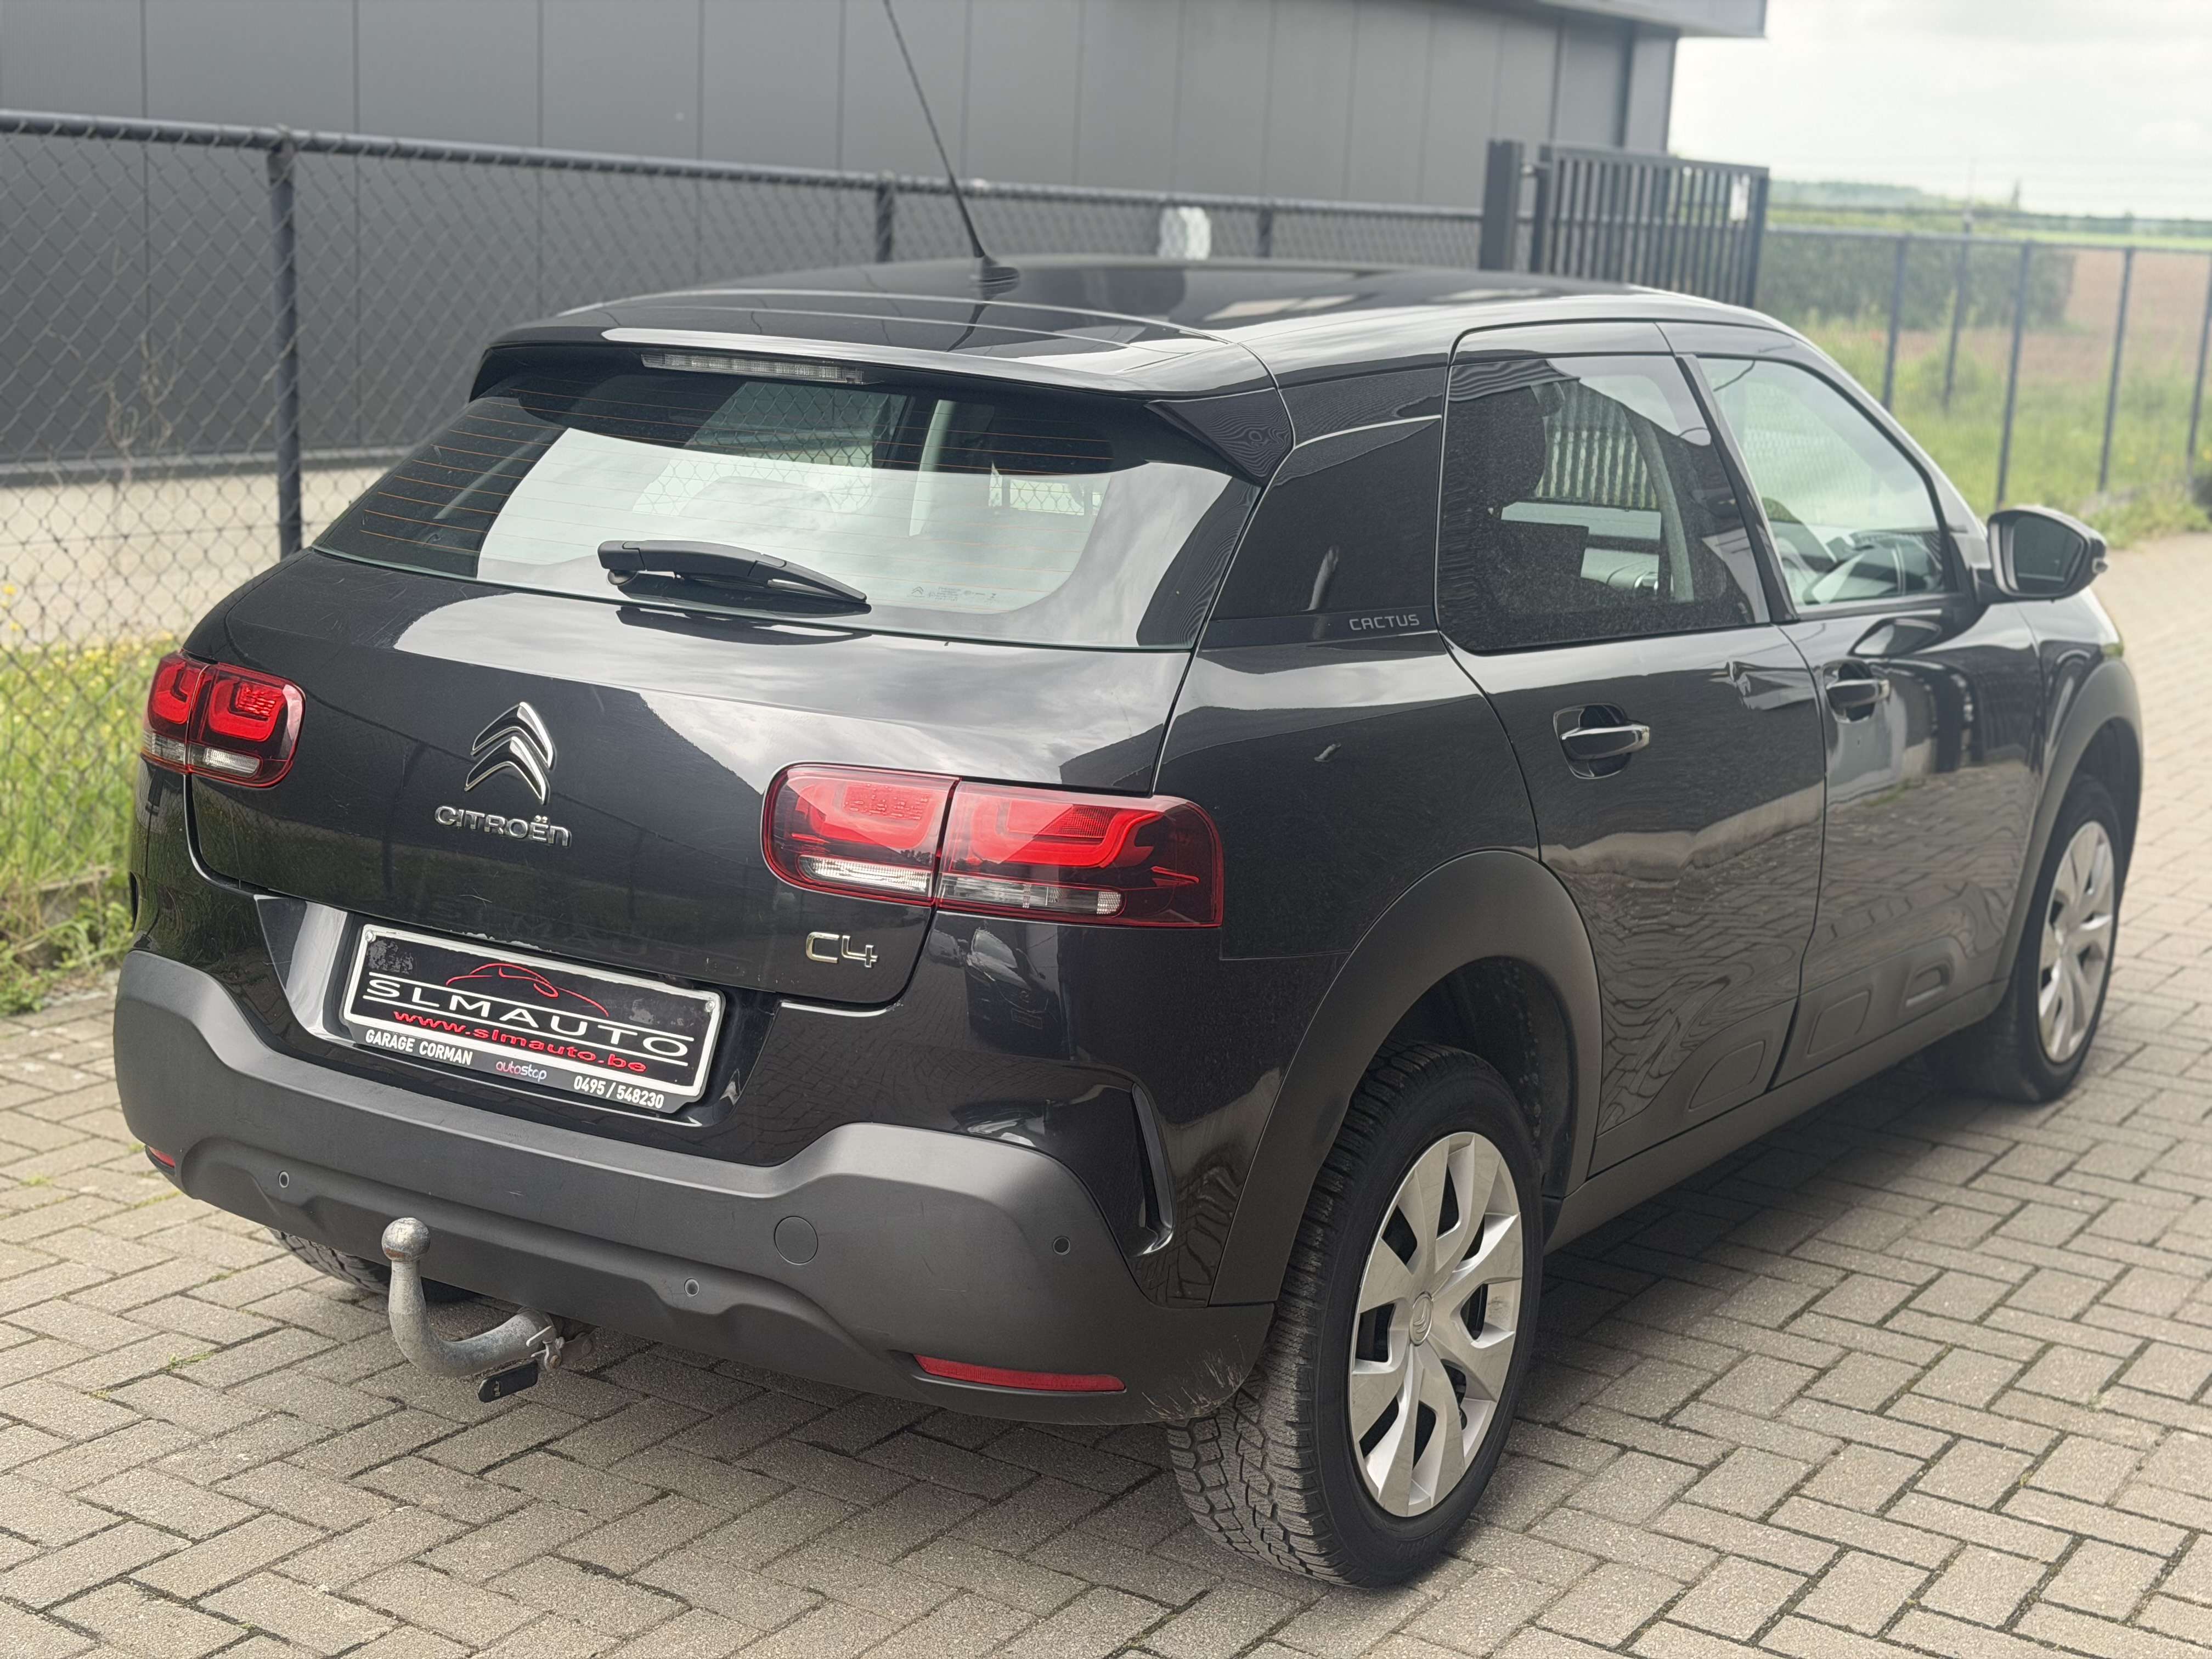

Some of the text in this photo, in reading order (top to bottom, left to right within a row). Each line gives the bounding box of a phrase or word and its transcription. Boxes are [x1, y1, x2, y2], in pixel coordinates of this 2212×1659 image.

[1349, 614, 1420, 630] CACTUS
[806, 932, 878, 968] C4
[366, 980, 688, 1057] SLMAUTO
[365, 1029, 473, 1065] GARAGE CORMAN
[393, 1011, 647, 1073] www.slmauto.be
[496, 1060, 547, 1082] autostop
